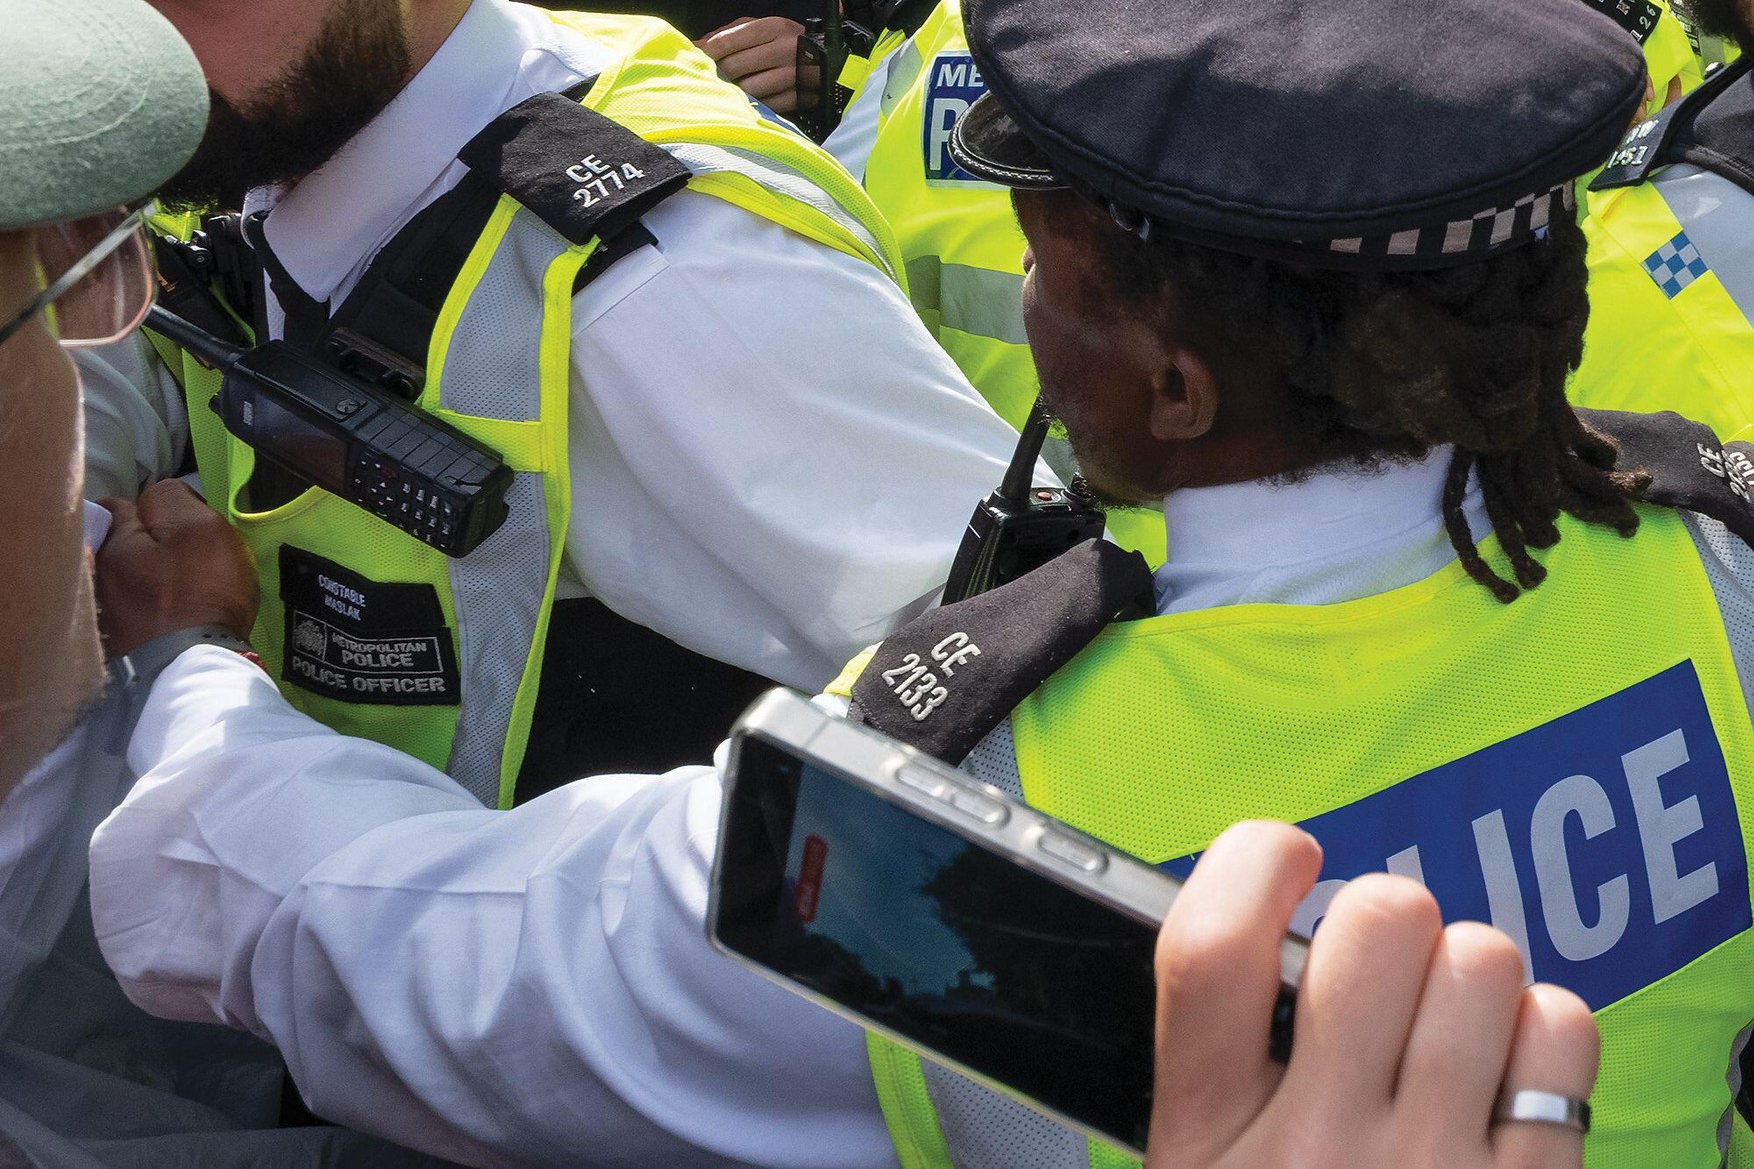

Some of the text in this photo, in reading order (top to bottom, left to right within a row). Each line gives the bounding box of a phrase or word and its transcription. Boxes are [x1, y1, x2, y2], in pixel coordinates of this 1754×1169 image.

[566, 154, 610, 183] CE
[573, 163, 646, 208] 2774
[1697, 443, 1726, 478] CE
[318, 574, 367, 608] CONSTABLE
[324, 594, 361, 621] MASLAK
[332, 633, 427, 653] METROPOLITAN
[342, 649, 414, 668] POLICE
[931, 632, 981, 678] CE
[292, 656, 446, 693] POLICE OFFICER
[881, 653, 948, 721] 2133
